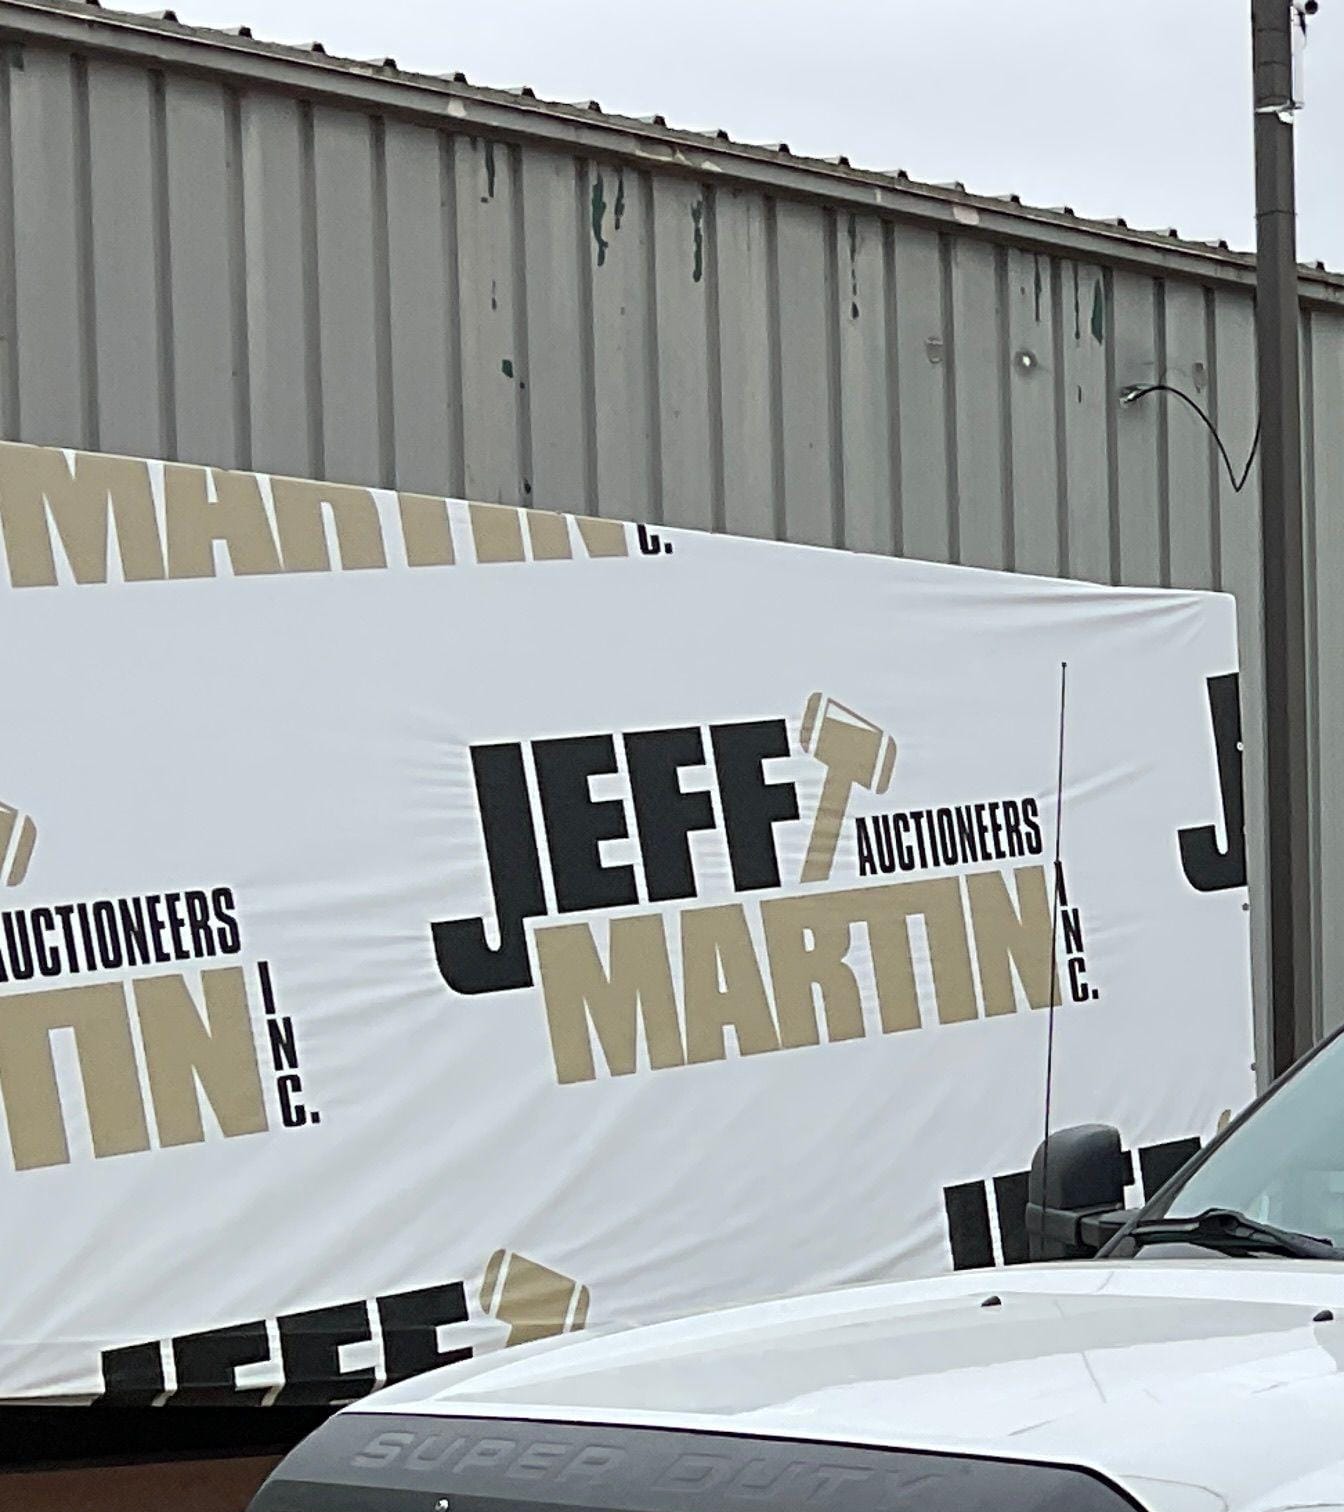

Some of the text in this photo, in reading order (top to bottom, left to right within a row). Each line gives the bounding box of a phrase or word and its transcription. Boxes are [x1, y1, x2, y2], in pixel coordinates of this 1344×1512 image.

[431, 719, 800, 995] JEFF
[855, 797, 1044, 876] AUCTIONEERS
[0, 887, 242, 982] UCTIONEERS
[533, 865, 1064, 1086] MARTIN
[350, 1430, 952, 1505] SUPER DUTY
